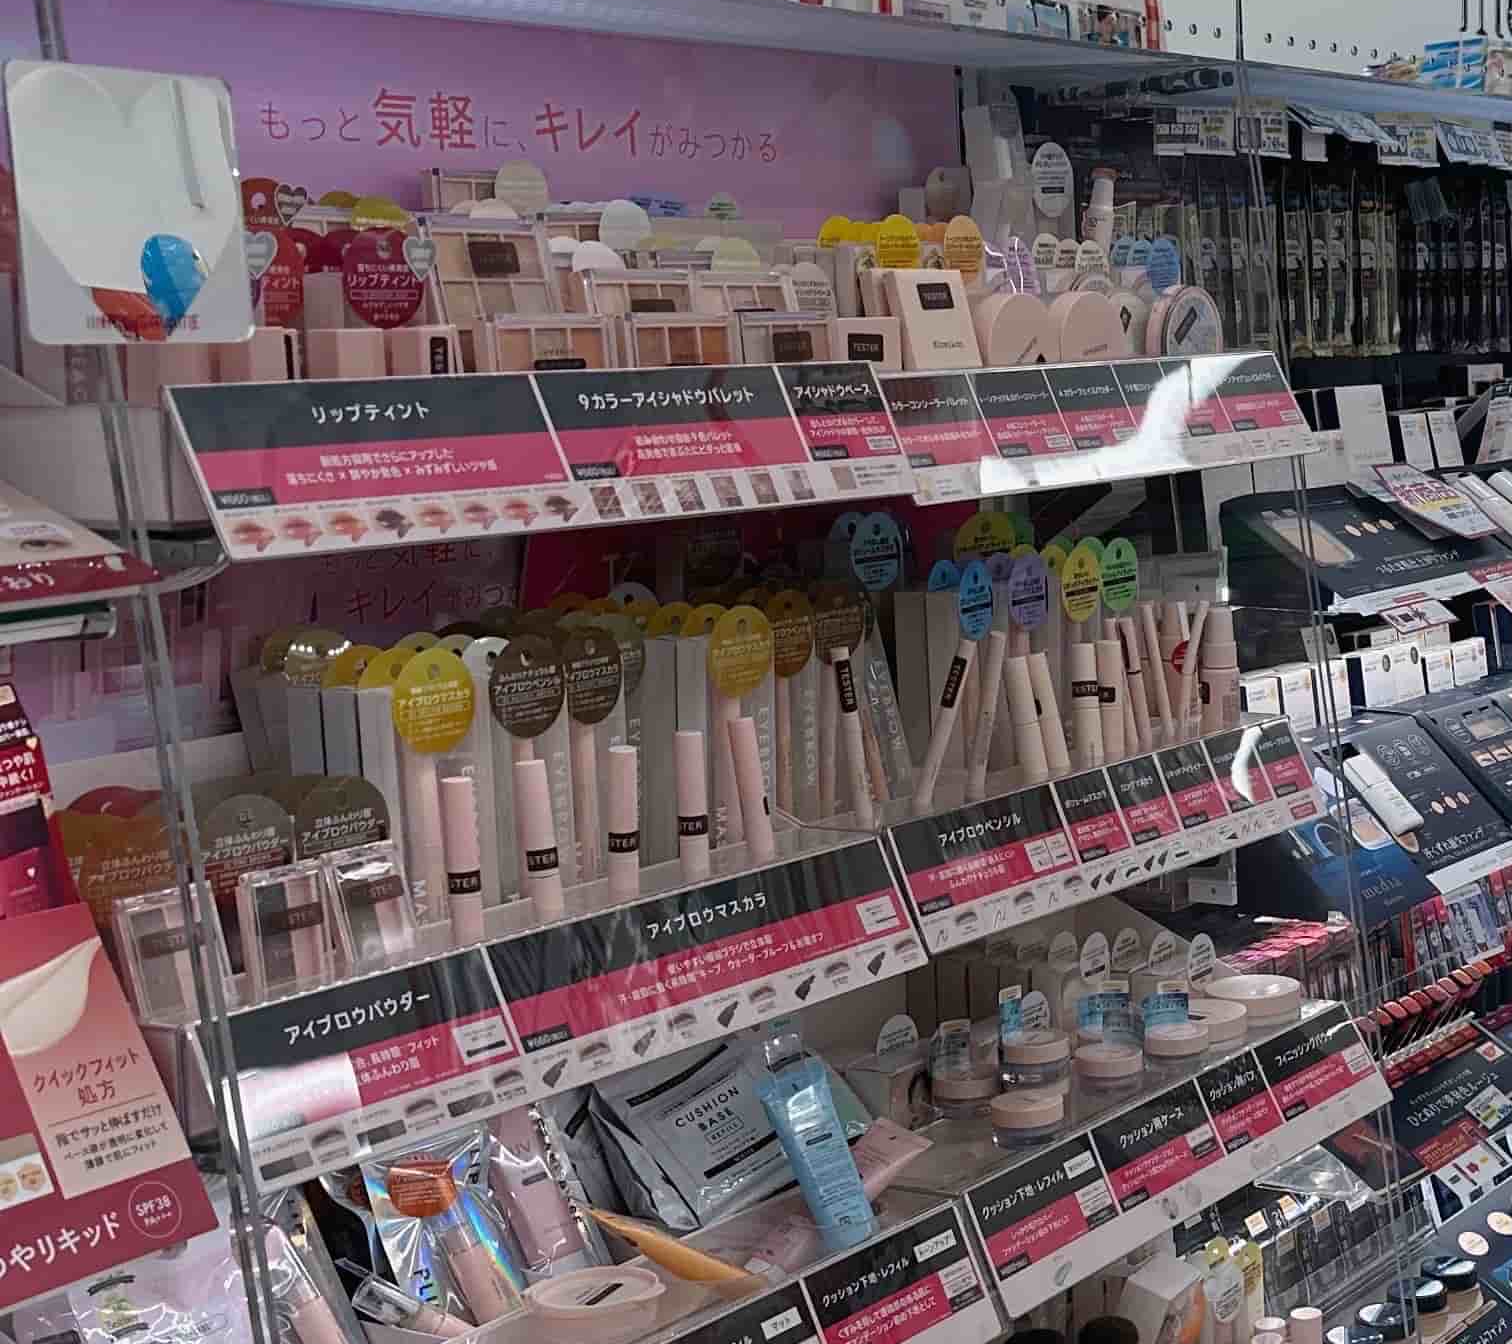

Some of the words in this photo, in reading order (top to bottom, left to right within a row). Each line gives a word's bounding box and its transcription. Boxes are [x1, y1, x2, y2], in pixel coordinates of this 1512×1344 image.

[577, 386, 755, 411] 9カラーアイシャドウパレット
[793, 382, 881, 399] アイシャドウベース
[311, 403, 432, 425] リップティント
[936, 813, 1023, 847] アイブロウペンシル
[645, 891, 768, 941] アイブロウマスカラ
[284, 990, 431, 1046] アイブロウパウダー
[32, 1046, 140, 1094] クイックフィット
[76, 1079, 117, 1108] 処方
[673, 1085, 742, 1130] CUSHION
[821, 1255, 911, 1309] クッション下地・レフィル
